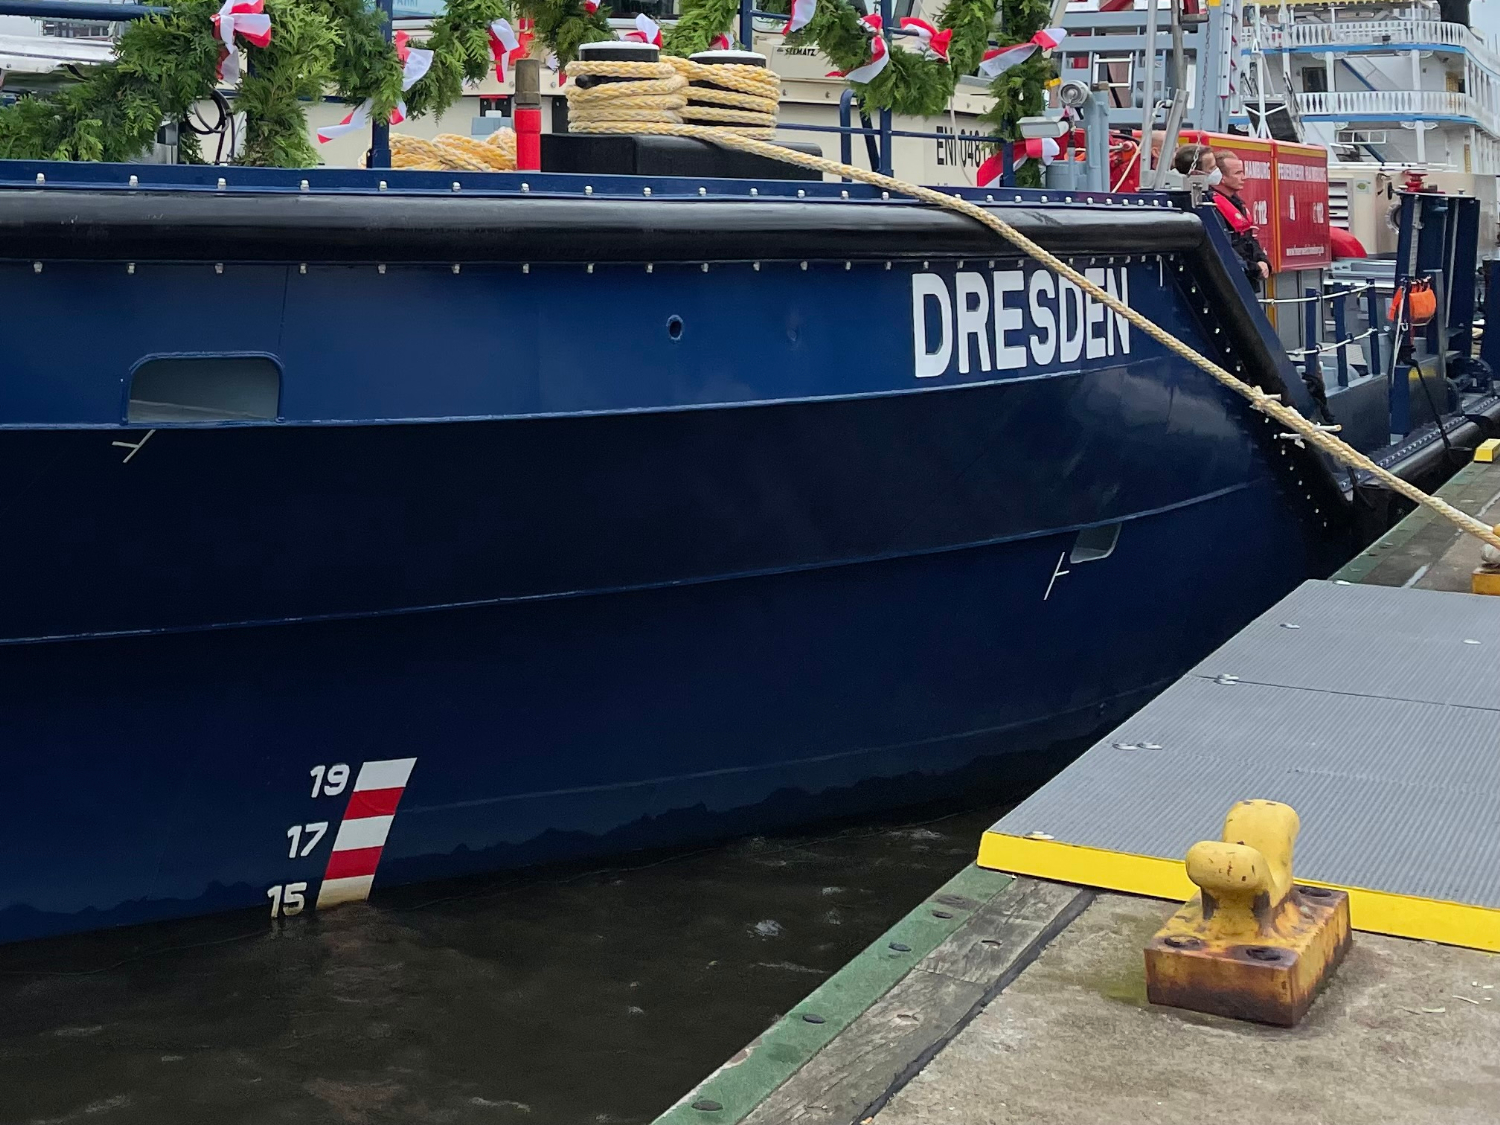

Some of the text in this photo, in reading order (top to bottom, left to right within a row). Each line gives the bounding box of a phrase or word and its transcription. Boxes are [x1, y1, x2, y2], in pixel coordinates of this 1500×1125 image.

[912, 266, 1131, 378] DRESDEN
[309, 763, 350, 799] 19
[286, 821, 329, 859] 17
[266, 882, 308, 919] 15
